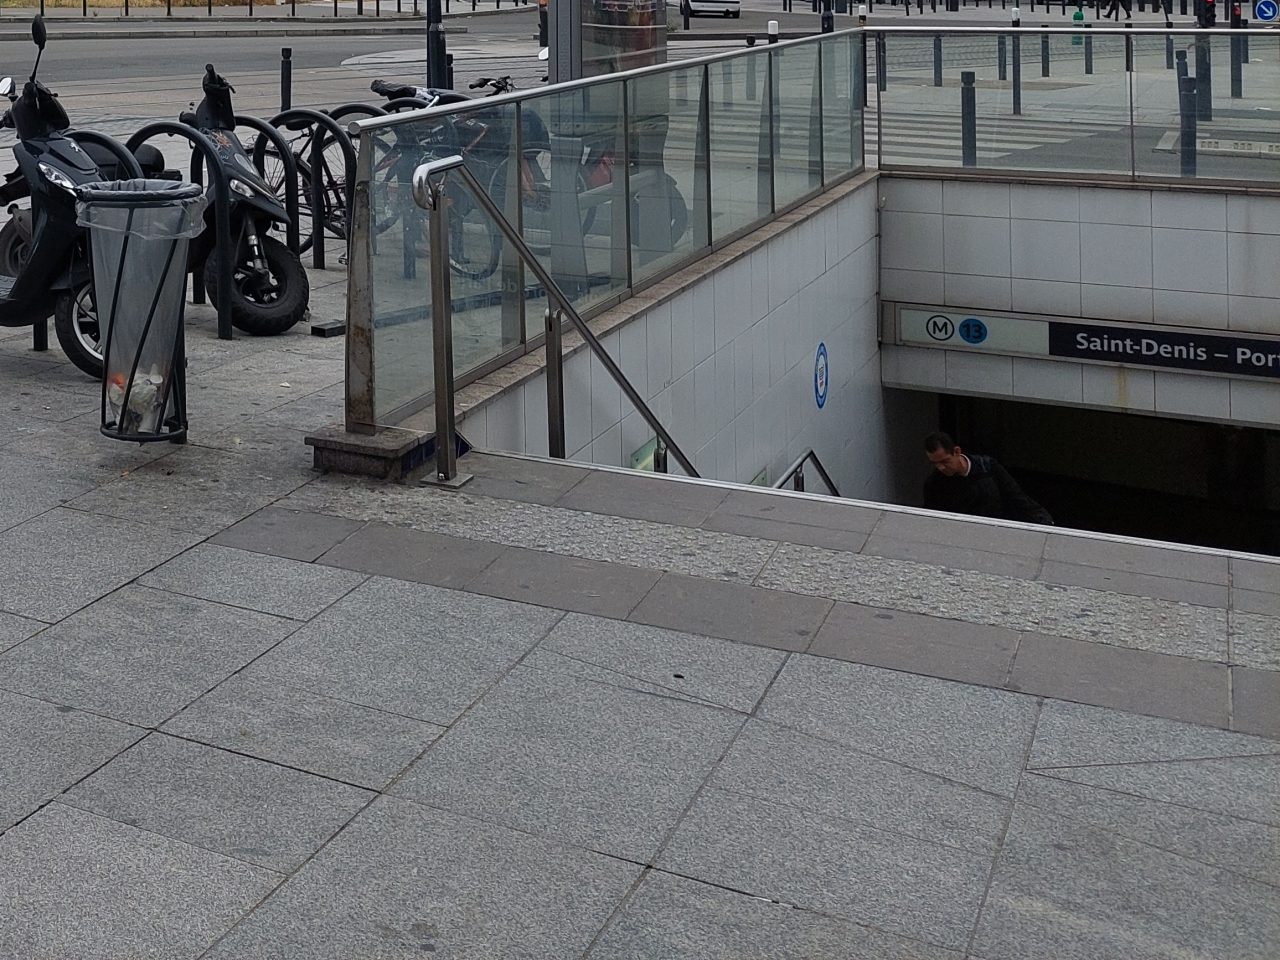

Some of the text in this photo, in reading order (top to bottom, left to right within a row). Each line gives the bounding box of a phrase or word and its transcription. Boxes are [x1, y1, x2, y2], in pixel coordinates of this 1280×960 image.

[962, 322, 984, 339] 13
[1076, 332, 1207, 361] Saint-Denis
[1236, 347, 1280, 367] Por
